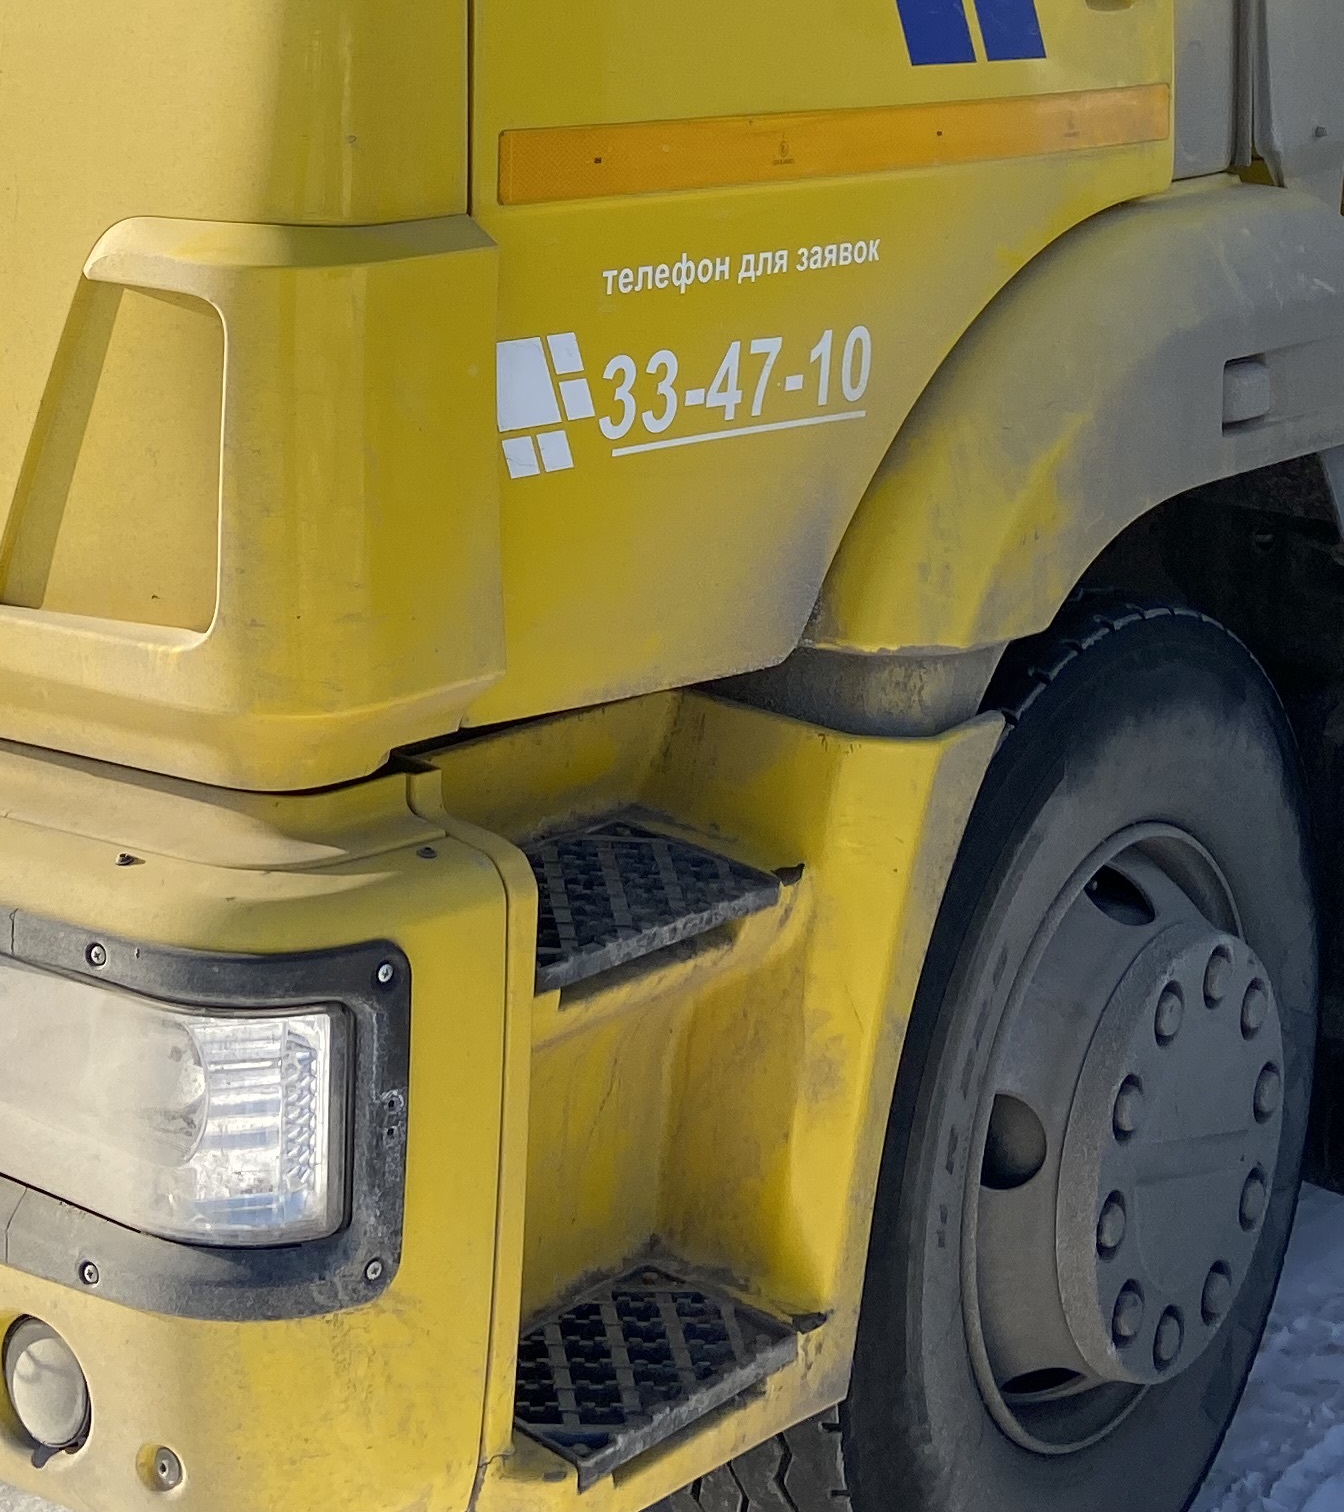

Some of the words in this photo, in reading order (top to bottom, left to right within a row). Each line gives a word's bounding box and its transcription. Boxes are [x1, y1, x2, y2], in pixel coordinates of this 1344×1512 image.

[602, 252, 730, 294] телефон
[737, 249, 789, 284] для
[796, 238, 881, 272] заявок
[598, 325, 873, 440] 33-47-10
